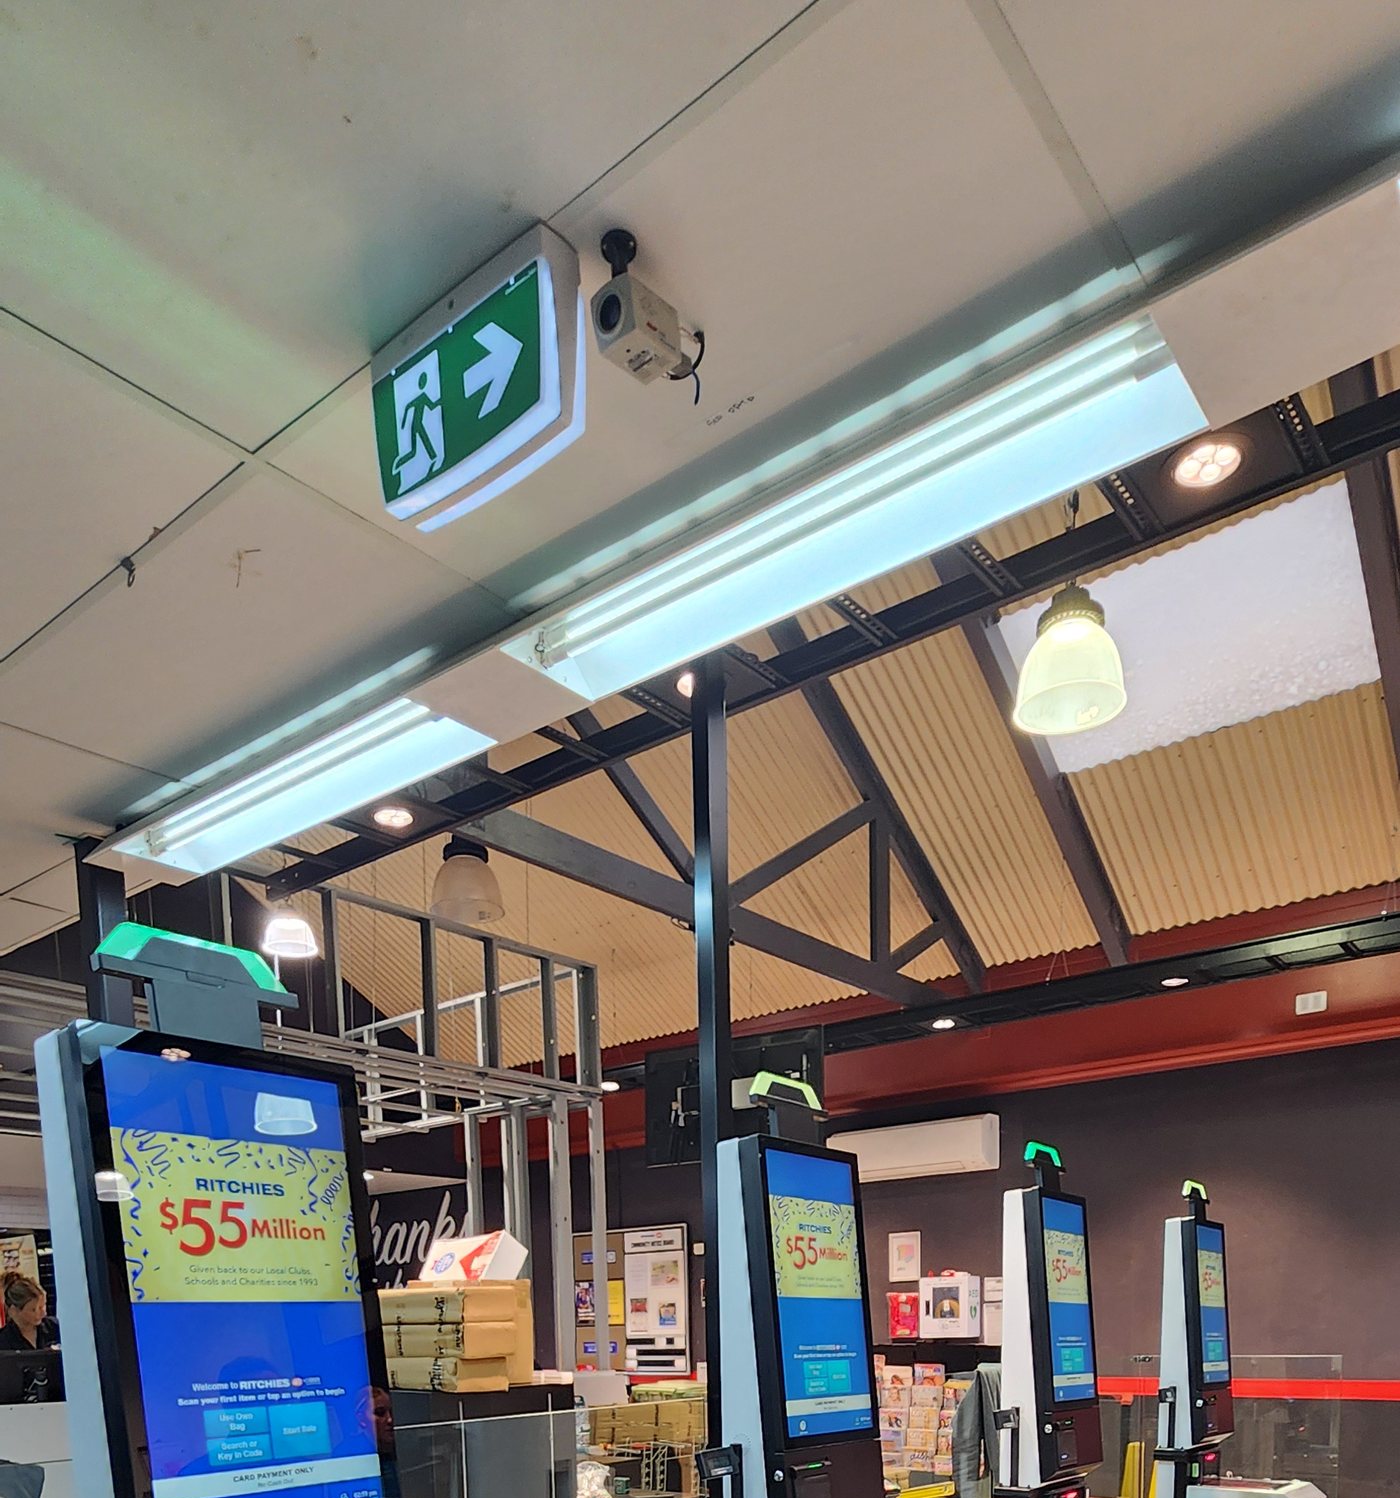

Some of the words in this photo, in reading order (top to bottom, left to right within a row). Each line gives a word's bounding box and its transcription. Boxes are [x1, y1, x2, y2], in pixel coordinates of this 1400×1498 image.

[195, 1177, 285, 1197] RITCHIES
[160, 1197, 248, 1257] $55
[251, 1219, 326, 1241] Million
[370, 1190, 468, 1266] hank
[786, 1235, 818, 1270] $55
[189, 1264, 216, 1274] Given
[217, 1264, 237, 1274] back
[238, 1266, 248, 1275] to
[249, 1267, 264, 1275] our
[265, 1266, 286, 1275] Local
[184, 1276, 219, 1286] Schools
[221, 1276, 237, 1286] and
[238, 1277, 275, 1286] Charities
[277, 1278, 297, 1286] since
[299, 1278, 318, 1286] 1993
[191, 1382, 229, 1392] Welcome
[230, 1381, 239, 1390] to
[239, 1378, 291, 1390] RITCHIES
[177, 1398, 199, 1407] Scan
[200, 1396, 220, 1407] your
[219, 1395, 237, 1405] first
[257, 1394, 267, 1402] or
[267, 1392, 281, 1402] tap
[292, 1389, 316, 1400] option
[315, 1388, 325, 1397] to
[325, 1387, 346, 1398] begin
[219, 1413, 235, 1422] Use
[235, 1412, 254, 1421] Own
[229, 1423, 246, 1433] Bag
[220, 1441, 249, 1451] Search
[249, 1440, 258, 1449] or
[217, 1450, 235, 1463] Key
[242, 1448, 264, 1459] Code
[233, 1473, 256, 1483] CARD
[257, 1468, 293, 1480] PAYMENT
[294, 1466, 315, 1476] ONLY
